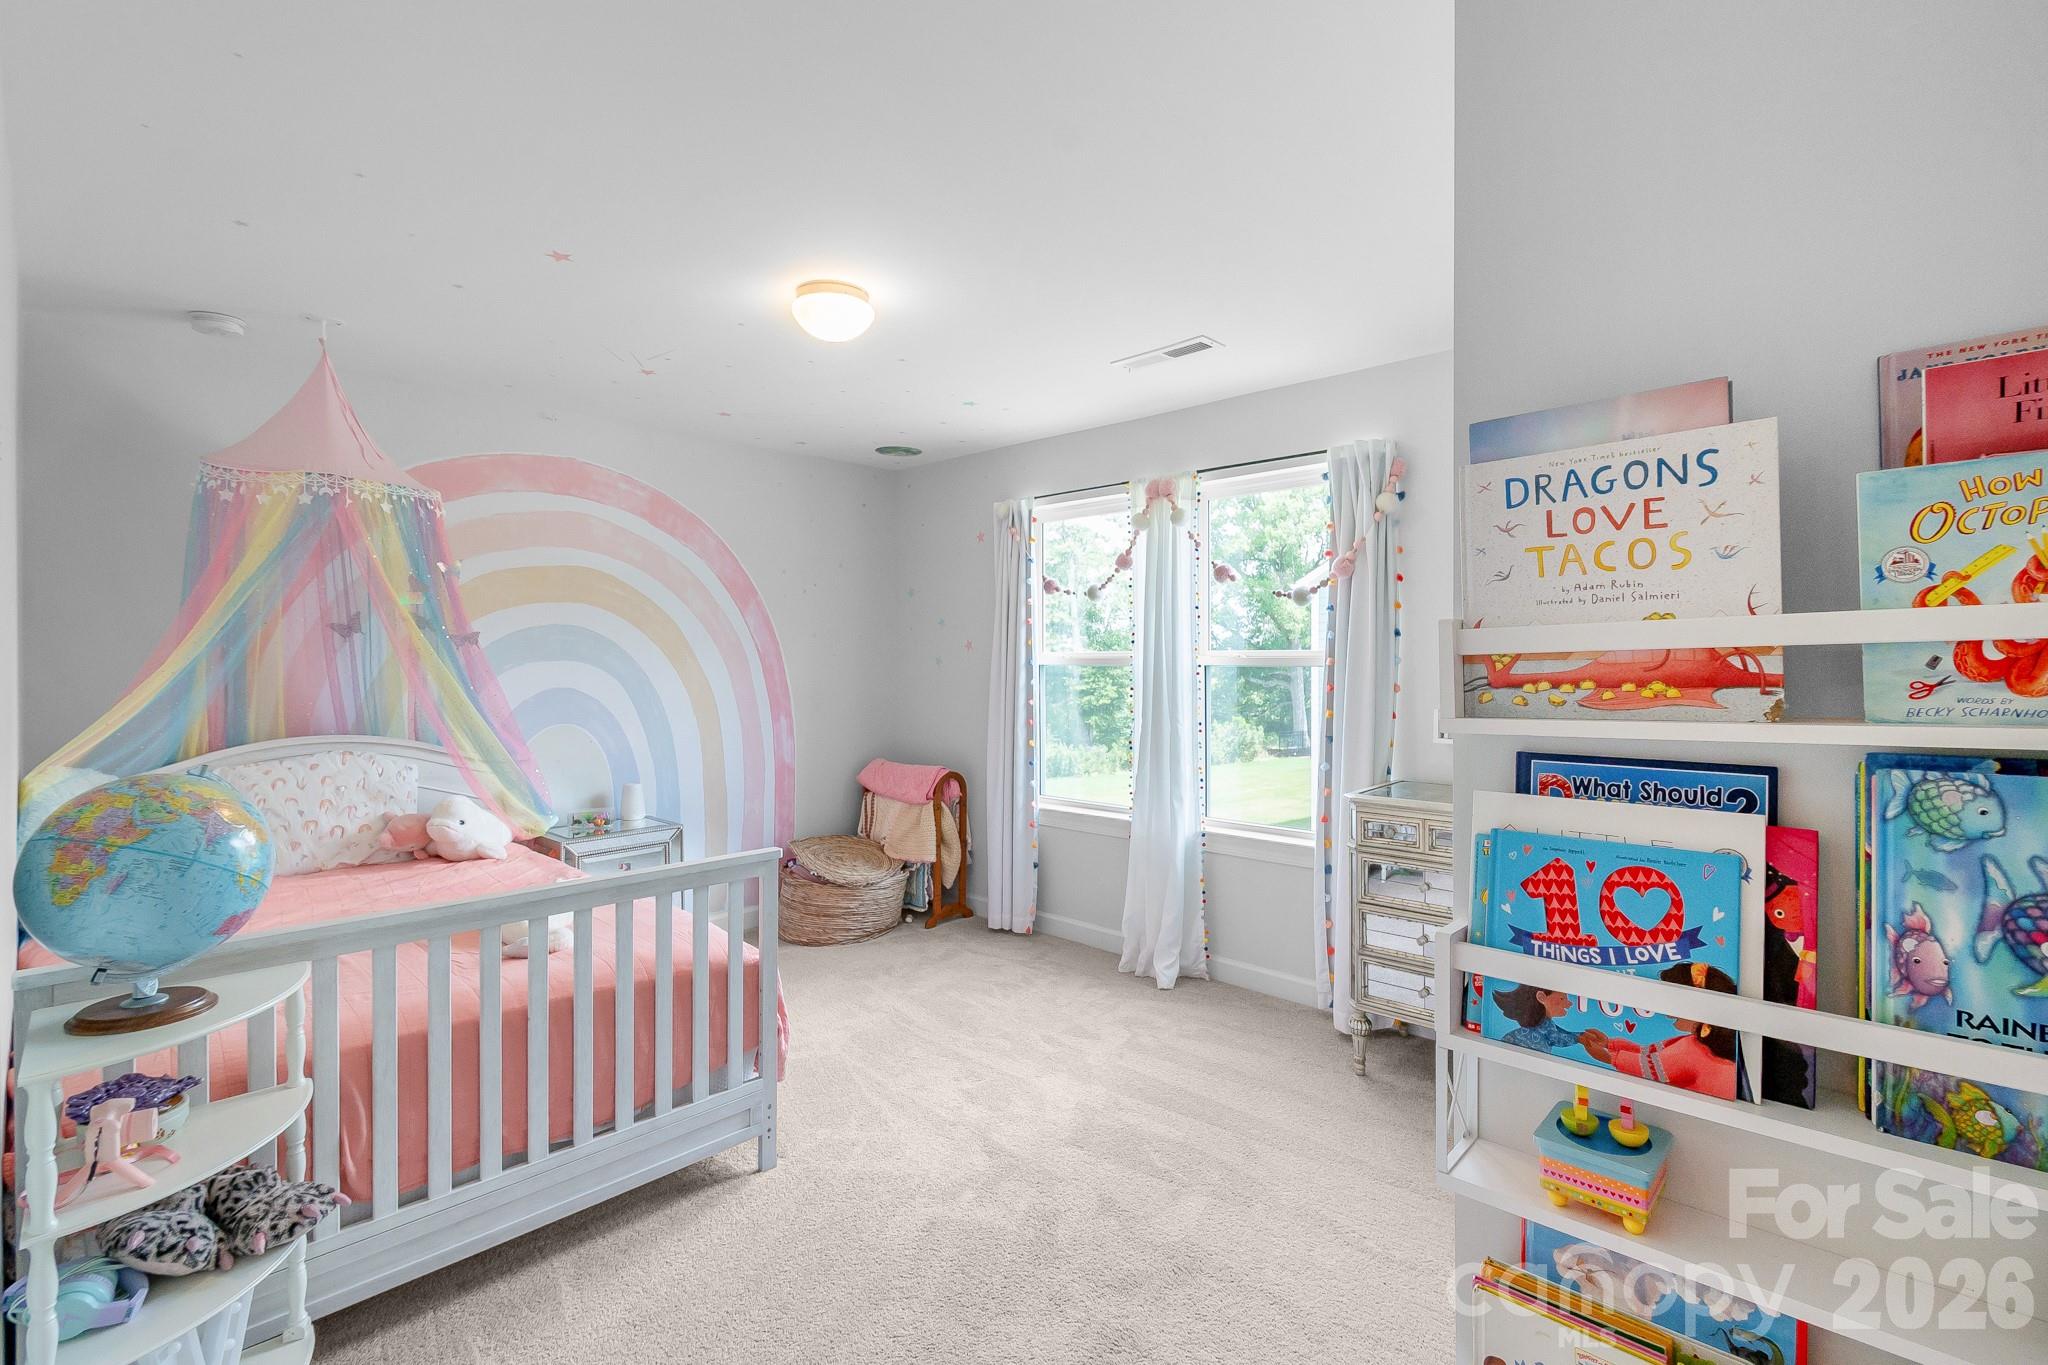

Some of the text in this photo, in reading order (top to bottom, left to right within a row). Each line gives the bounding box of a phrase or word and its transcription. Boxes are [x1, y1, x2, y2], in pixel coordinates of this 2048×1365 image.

[1927, 349, 1953, 359] THE
[1959, 344, 1987, 353] NEW
[1993, 336, 2029, 347] YORK
[1995, 372, 2048, 399] Lit
[1504, 448, 1719, 510] DRAGONS
[1958, 468, 2043, 502] HOW
[1545, 496, 1669, 538] LOVE
[1524, 530, 1693, 578] TACOS
[1561, 579, 1644, 594] by Adam Rubin
[1591, 592, 1626, 605] Daniel
[1630, 590, 1681, 602] Salmieri
[1906, 706, 1955, 718] BECKY
[1956, 697, 2015, 705] WORDS BY
[1571, 775, 1632, 799] What
[1638, 780, 1724, 808] Should
[1520, 857, 1685, 948] 10
[1531, 939, 1682, 966] THINGS I LOVE
